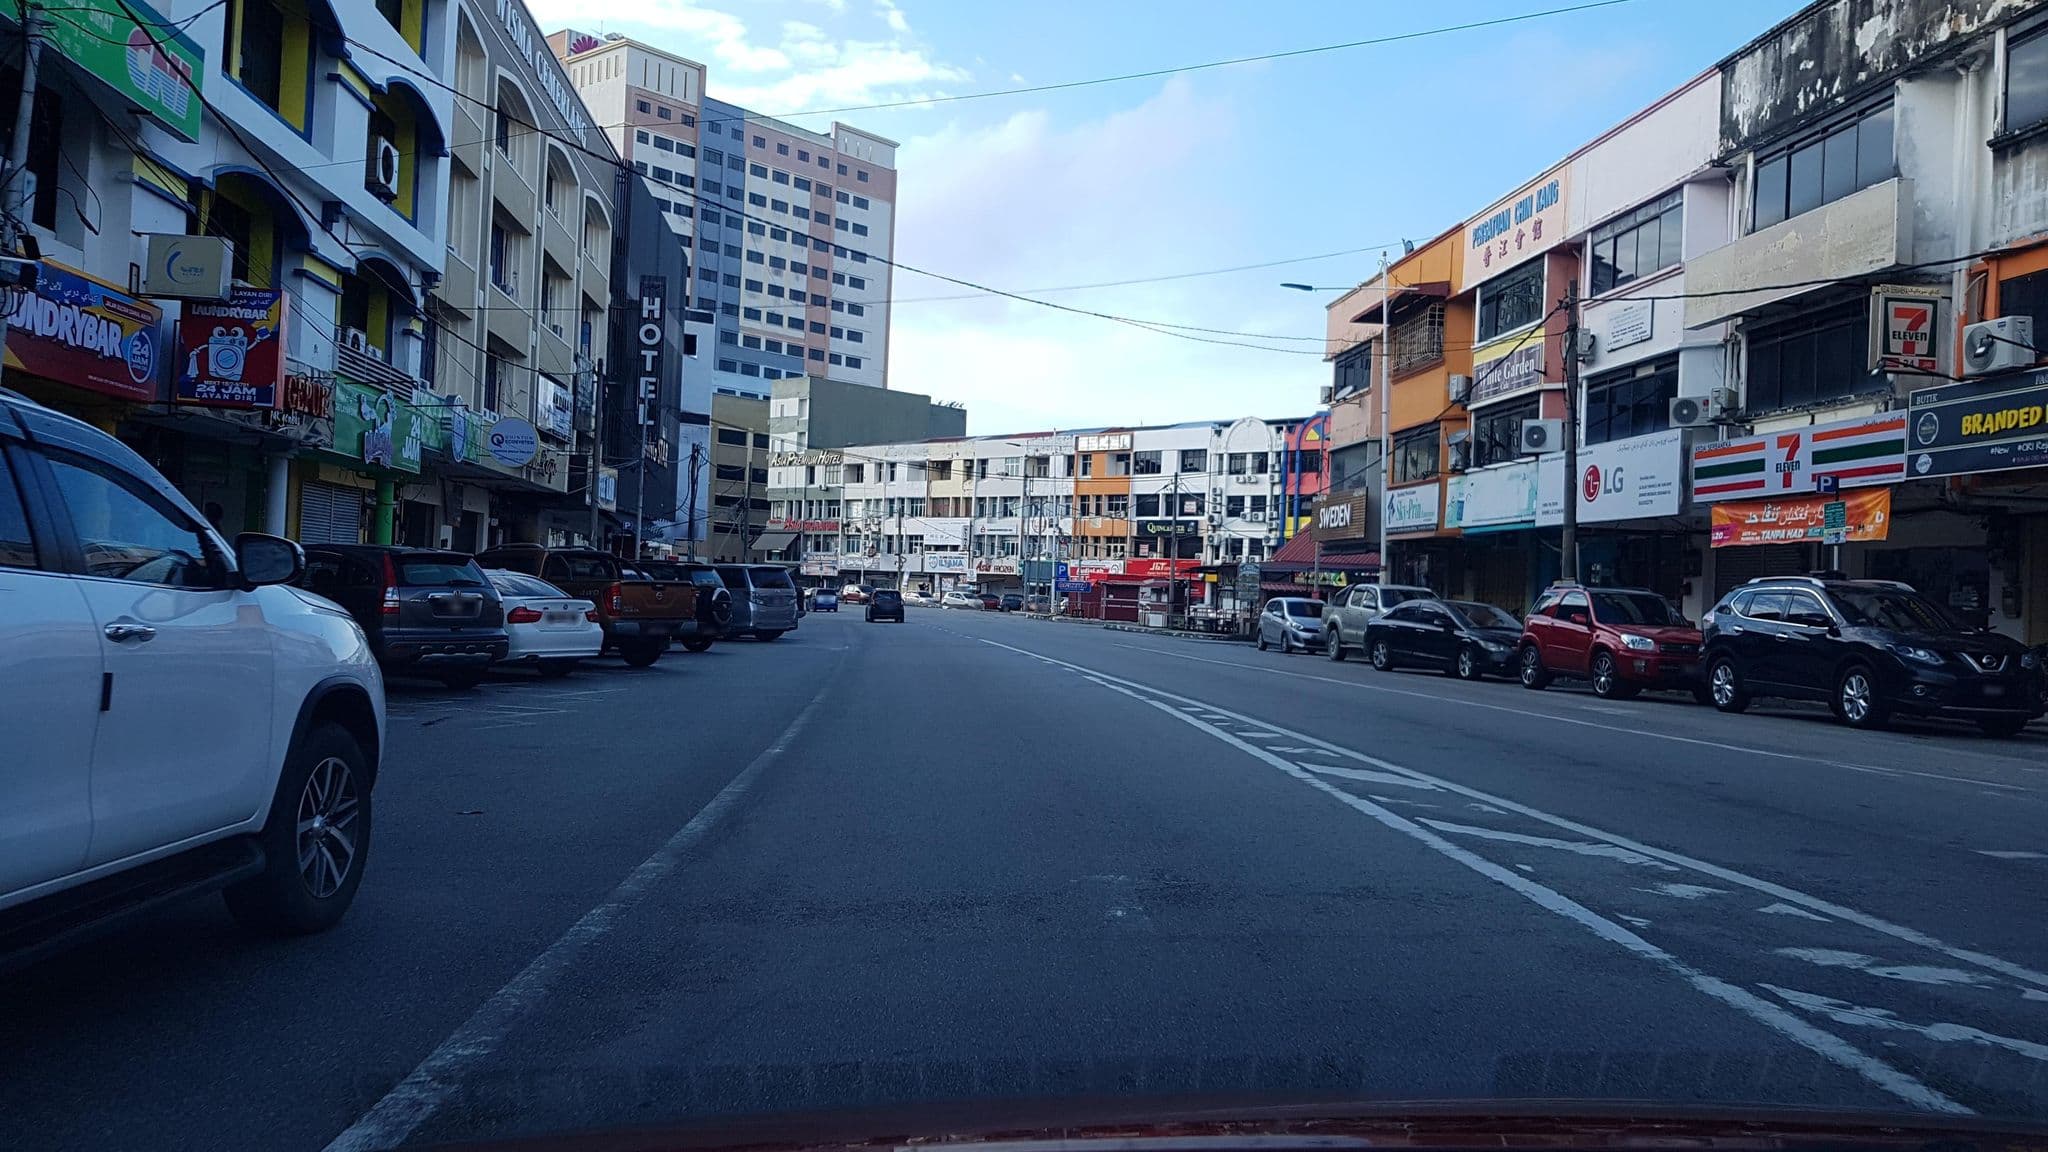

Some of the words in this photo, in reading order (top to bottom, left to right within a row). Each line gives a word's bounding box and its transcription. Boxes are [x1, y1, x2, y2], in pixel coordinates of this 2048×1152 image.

[496, 0, 533, 68] WISMA
[536, 51, 588, 149] CEMERLANG
[1472, 207, 1511, 250] PERSATUAN
[1514, 194, 1534, 226] CHIN
[1536, 179, 1560, 214] KANG
[234, 290, 257, 298] LAYAN
[192, 303, 268, 320] LAUNDRYBAR
[7, 290, 122, 358] UNDRYBAR
[1894, 307, 1928, 355] 7
[132, 339, 149, 357] 24
[132, 355, 149, 366] JAM
[638, 296, 662, 426] HOTEL
[1503, 356, 1535, 380] Garden
[195, 391, 230, 400] LAYAN
[234, 394, 257, 402] DIRI
[196, 384, 217, 393] 24
[221, 384, 257, 396] JAM
[1916, 393, 1939, 405] BUTIK
[410, 414, 421, 440] 24
[1961, 405, 2043, 437] BRANDED
[402, 436, 420, 462] JAM
[1777, 432, 1800, 489] 7
[1603, 466, 1624, 495] LG
[1820, 476, 1832, 492] P
[1318, 503, 1351, 529] SWEDEN
[1760, 529, 1787, 540] TANPA
[1787, 528, 1804, 539] HAD
[1058, 565, 1066, 575] P
[1149, 562, 1168, 571] J&T
